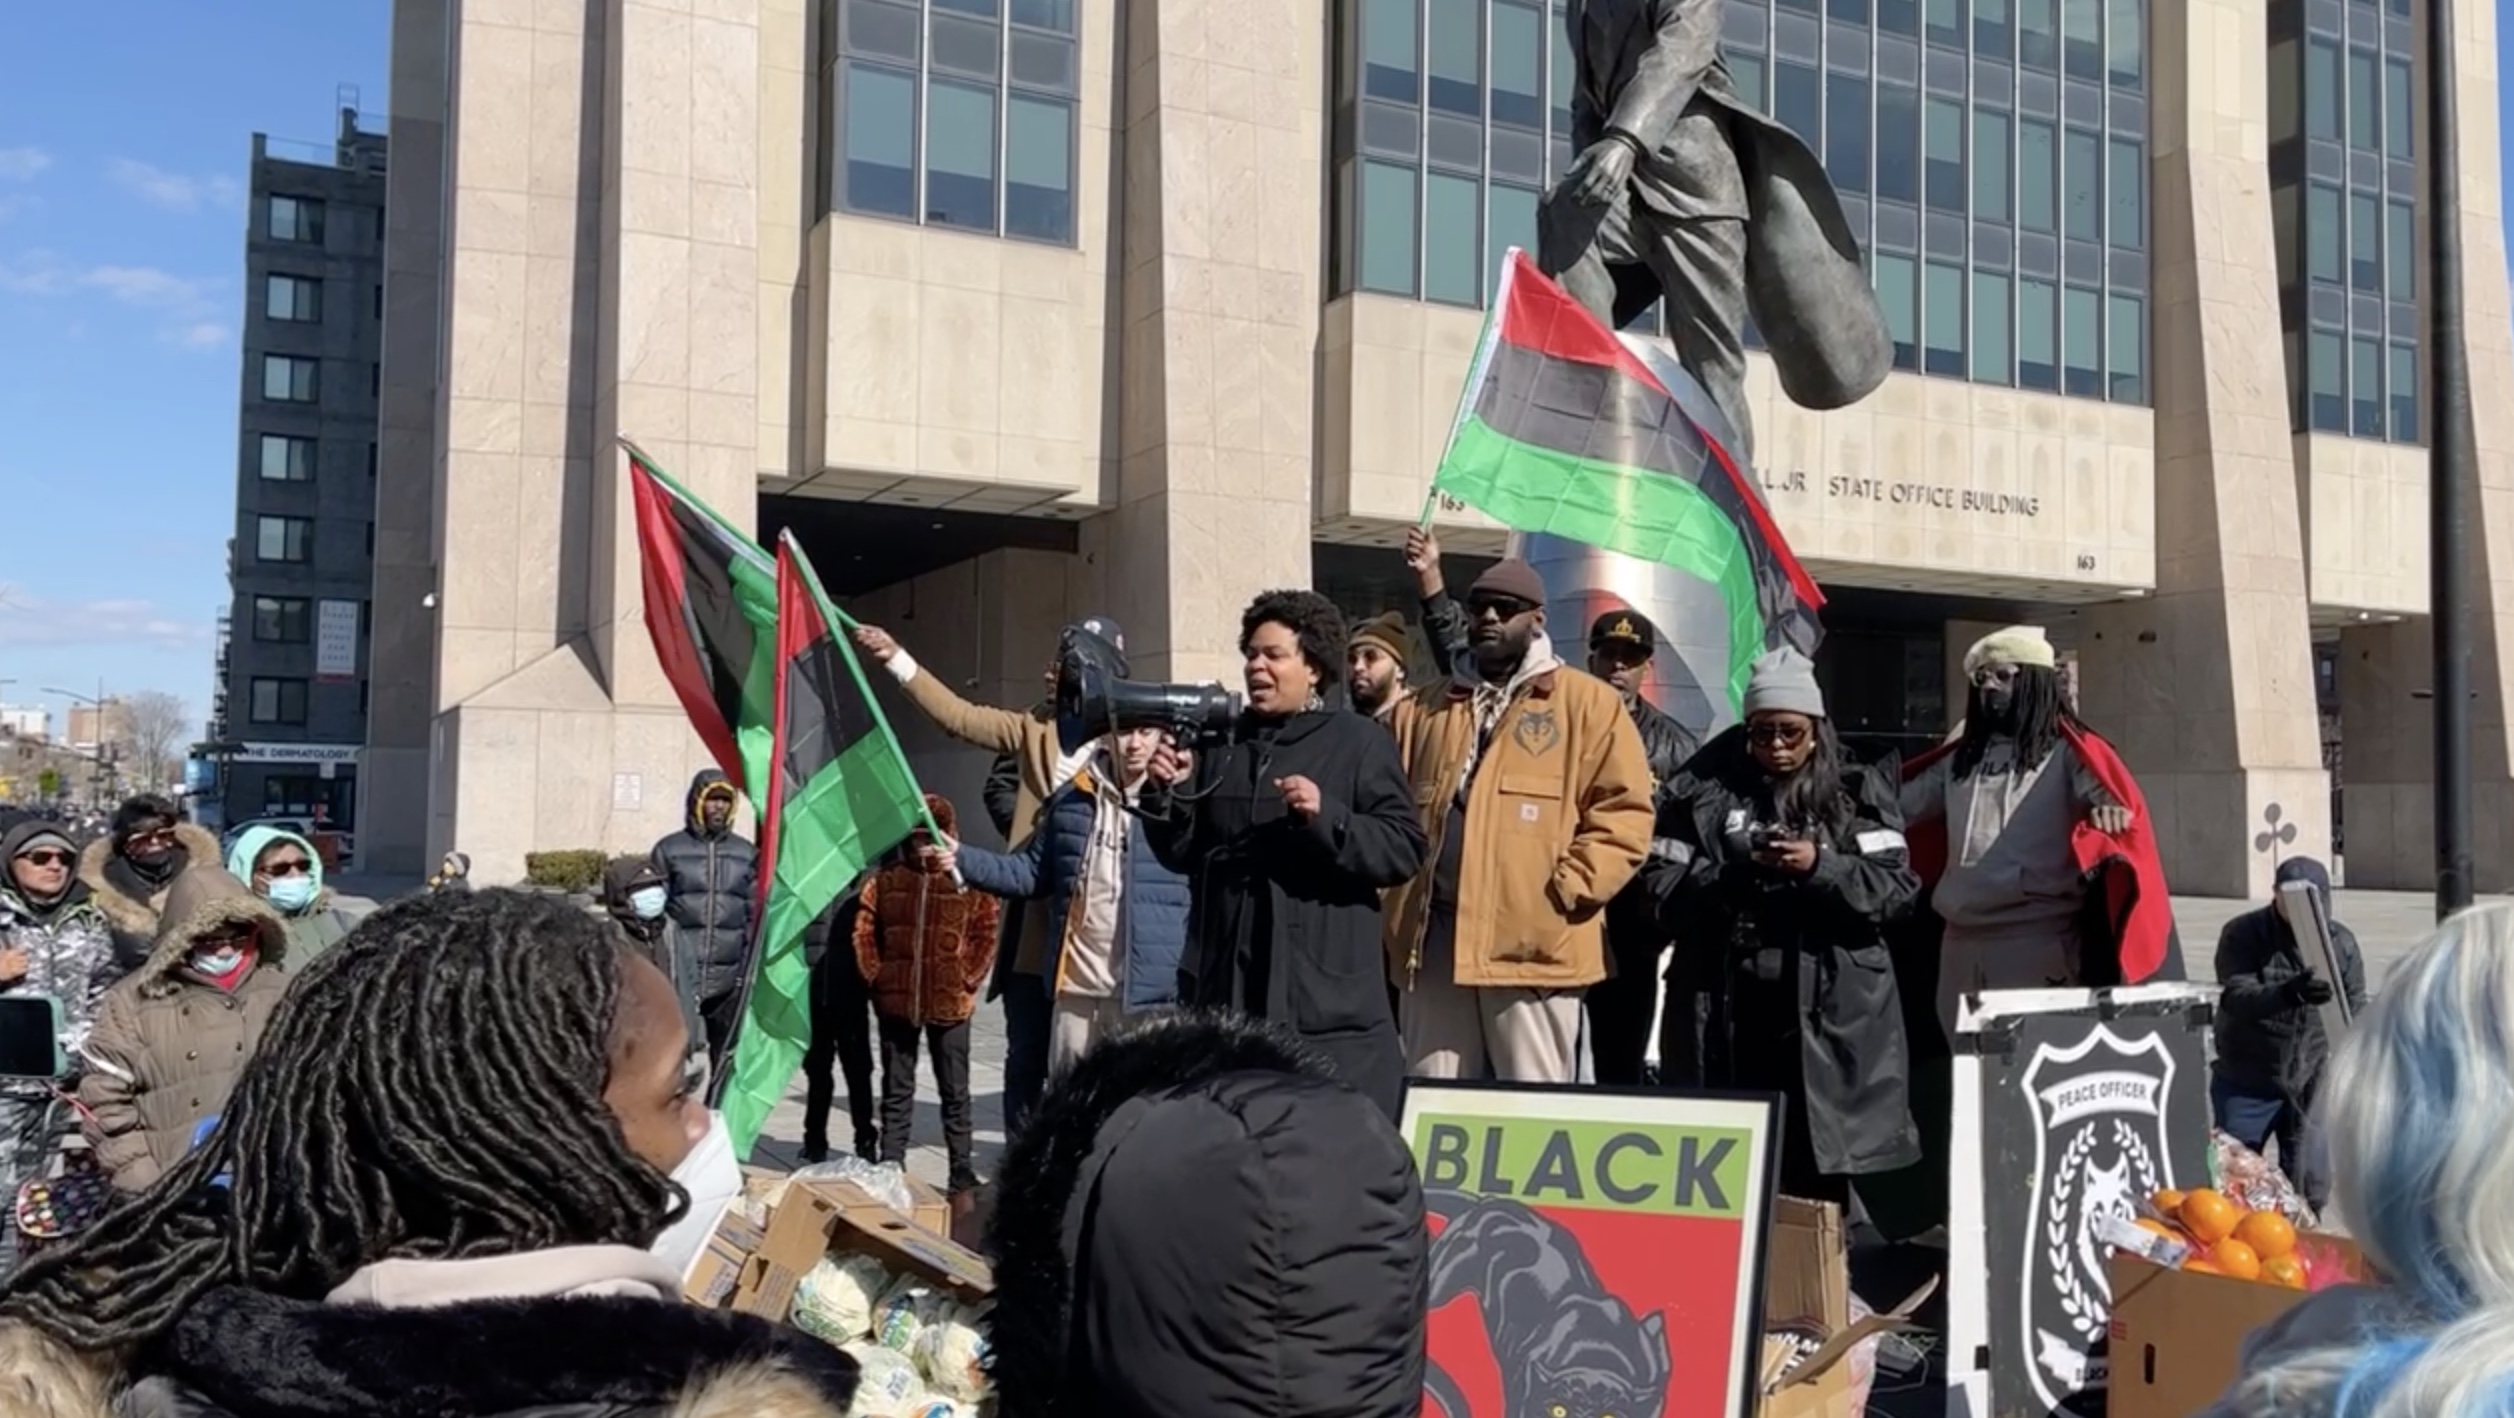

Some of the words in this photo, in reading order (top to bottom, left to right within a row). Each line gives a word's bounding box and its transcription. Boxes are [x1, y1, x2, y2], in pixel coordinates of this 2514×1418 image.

[1829, 476, 1882, 501] STATE
[1890, 483, 1954, 508] OFFICE
[1962, 489, 2040, 517] BUILDING
[2077, 555, 2096, 571] 163
[270, 747, 350, 759] DERMATOLOGY
[2058, 1083, 2096, 1110] PEACE
[2099, 1080, 2147, 1100] OFFICER
[1424, 1123, 1739, 1210] BLACK
